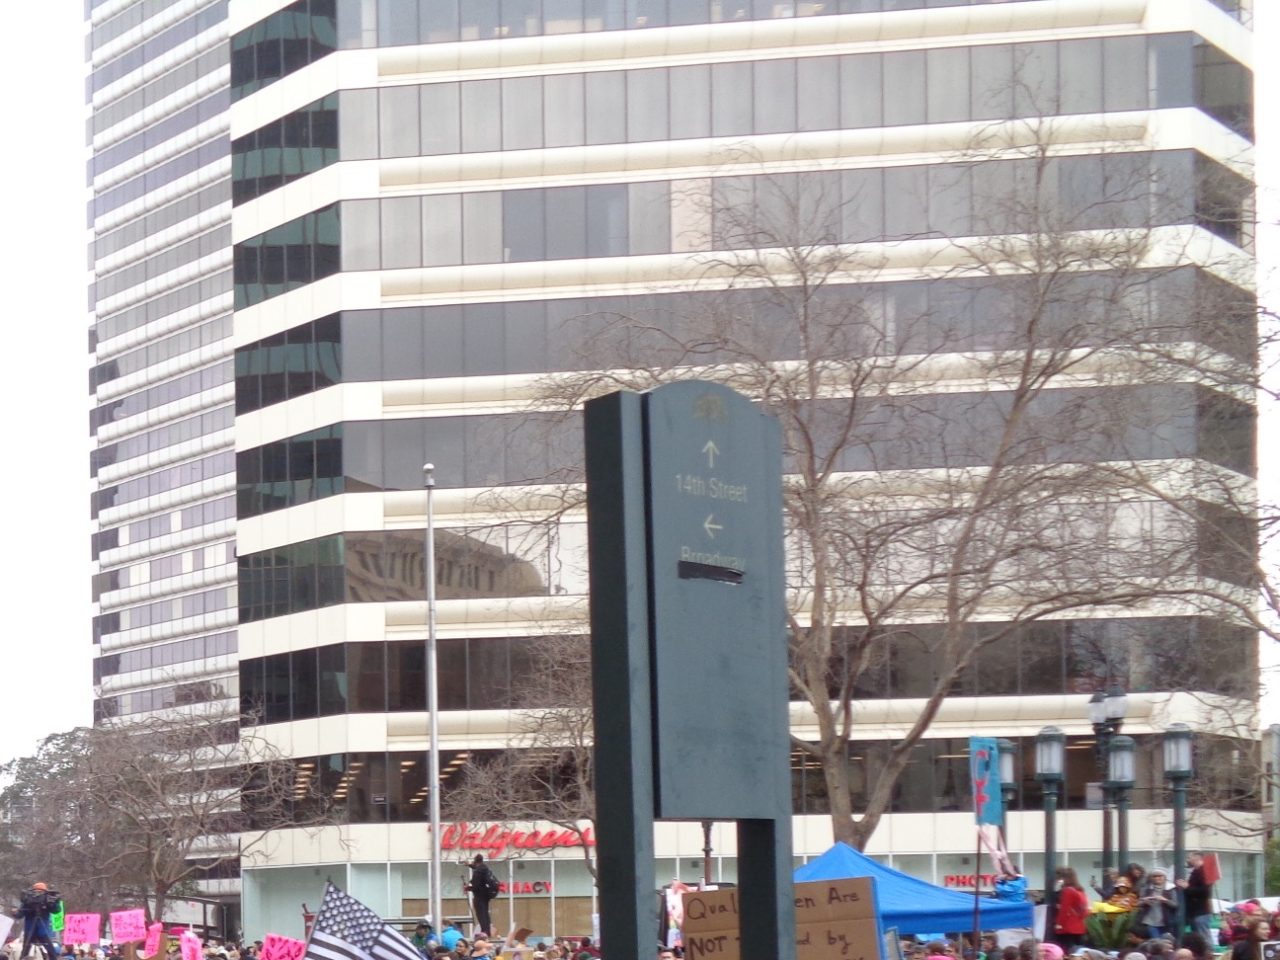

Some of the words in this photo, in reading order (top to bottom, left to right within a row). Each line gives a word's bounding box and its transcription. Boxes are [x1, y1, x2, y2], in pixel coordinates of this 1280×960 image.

[675, 474, 705, 496] 14th
[710, 478, 748, 502] Street
[828, 887, 860, 905] Are
[689, 935, 727, 960] NOT
[828, 930, 851, 955] by
